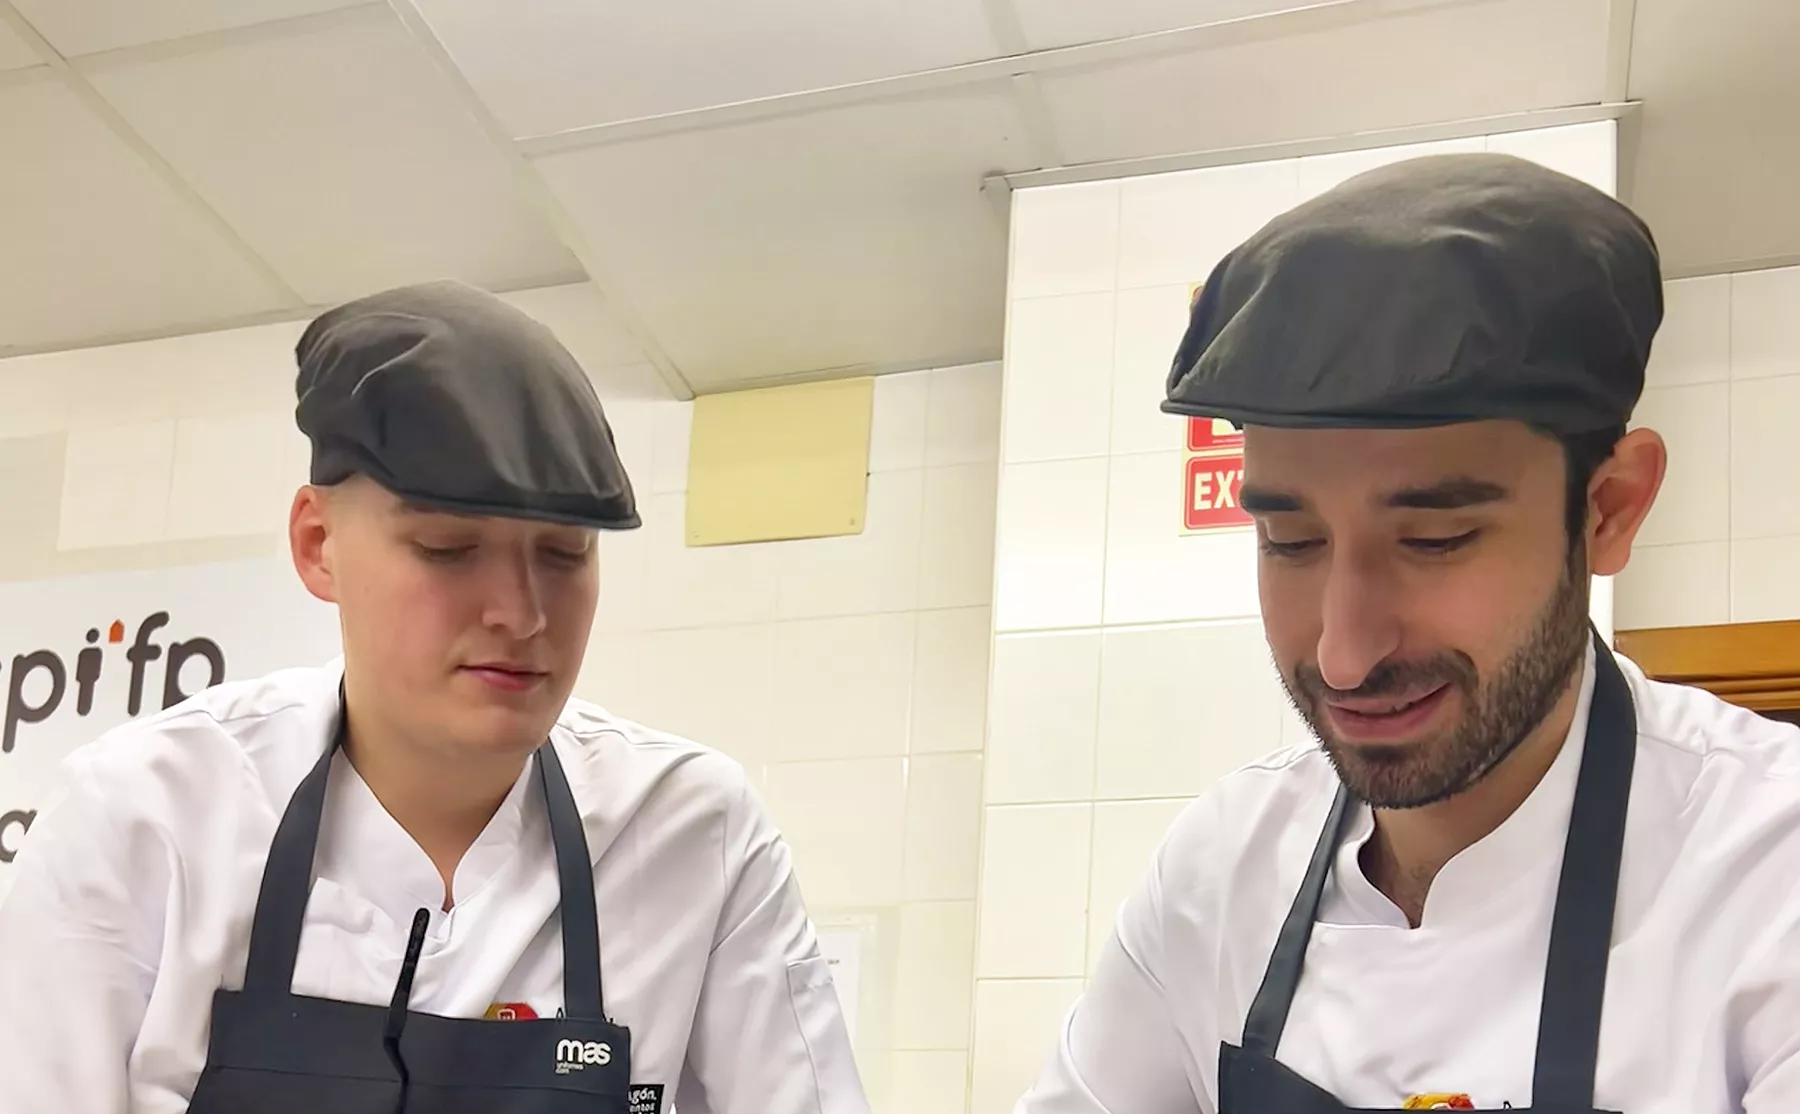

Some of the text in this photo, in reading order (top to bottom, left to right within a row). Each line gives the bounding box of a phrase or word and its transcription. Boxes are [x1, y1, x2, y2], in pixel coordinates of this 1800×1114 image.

[1193, 469, 1244, 511] EX
[0, 611, 226, 754] pifp
[556, 1039, 612, 1065] mas
